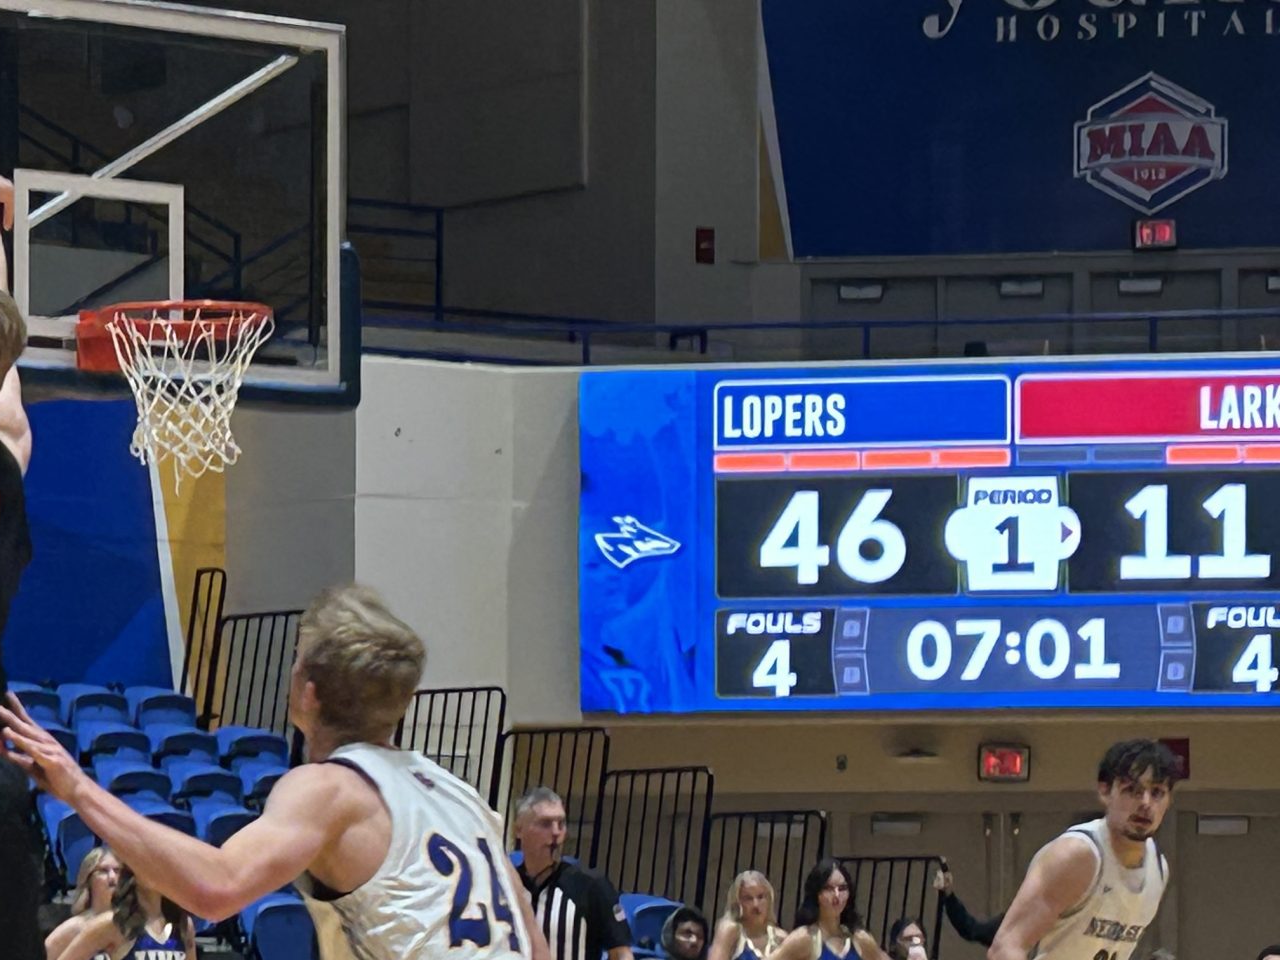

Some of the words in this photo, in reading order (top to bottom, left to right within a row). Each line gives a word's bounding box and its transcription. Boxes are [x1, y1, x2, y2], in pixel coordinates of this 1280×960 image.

[1087, 122, 1215, 163] MIAA
[723, 393, 846, 438] LOPERS
[1199, 385, 1280, 430] LARK
[974, 488, 1052, 504] PERIOD
[760, 488, 907, 585] 46
[992, 515, 1035, 573] 1
[1120, 483, 1271, 579] 11
[727, 611, 822, 635] FOULS
[907, 617, 1121, 681] 07:01
[752, 639, 797, 697] 4
[1232, 634, 1279, 692] 4
